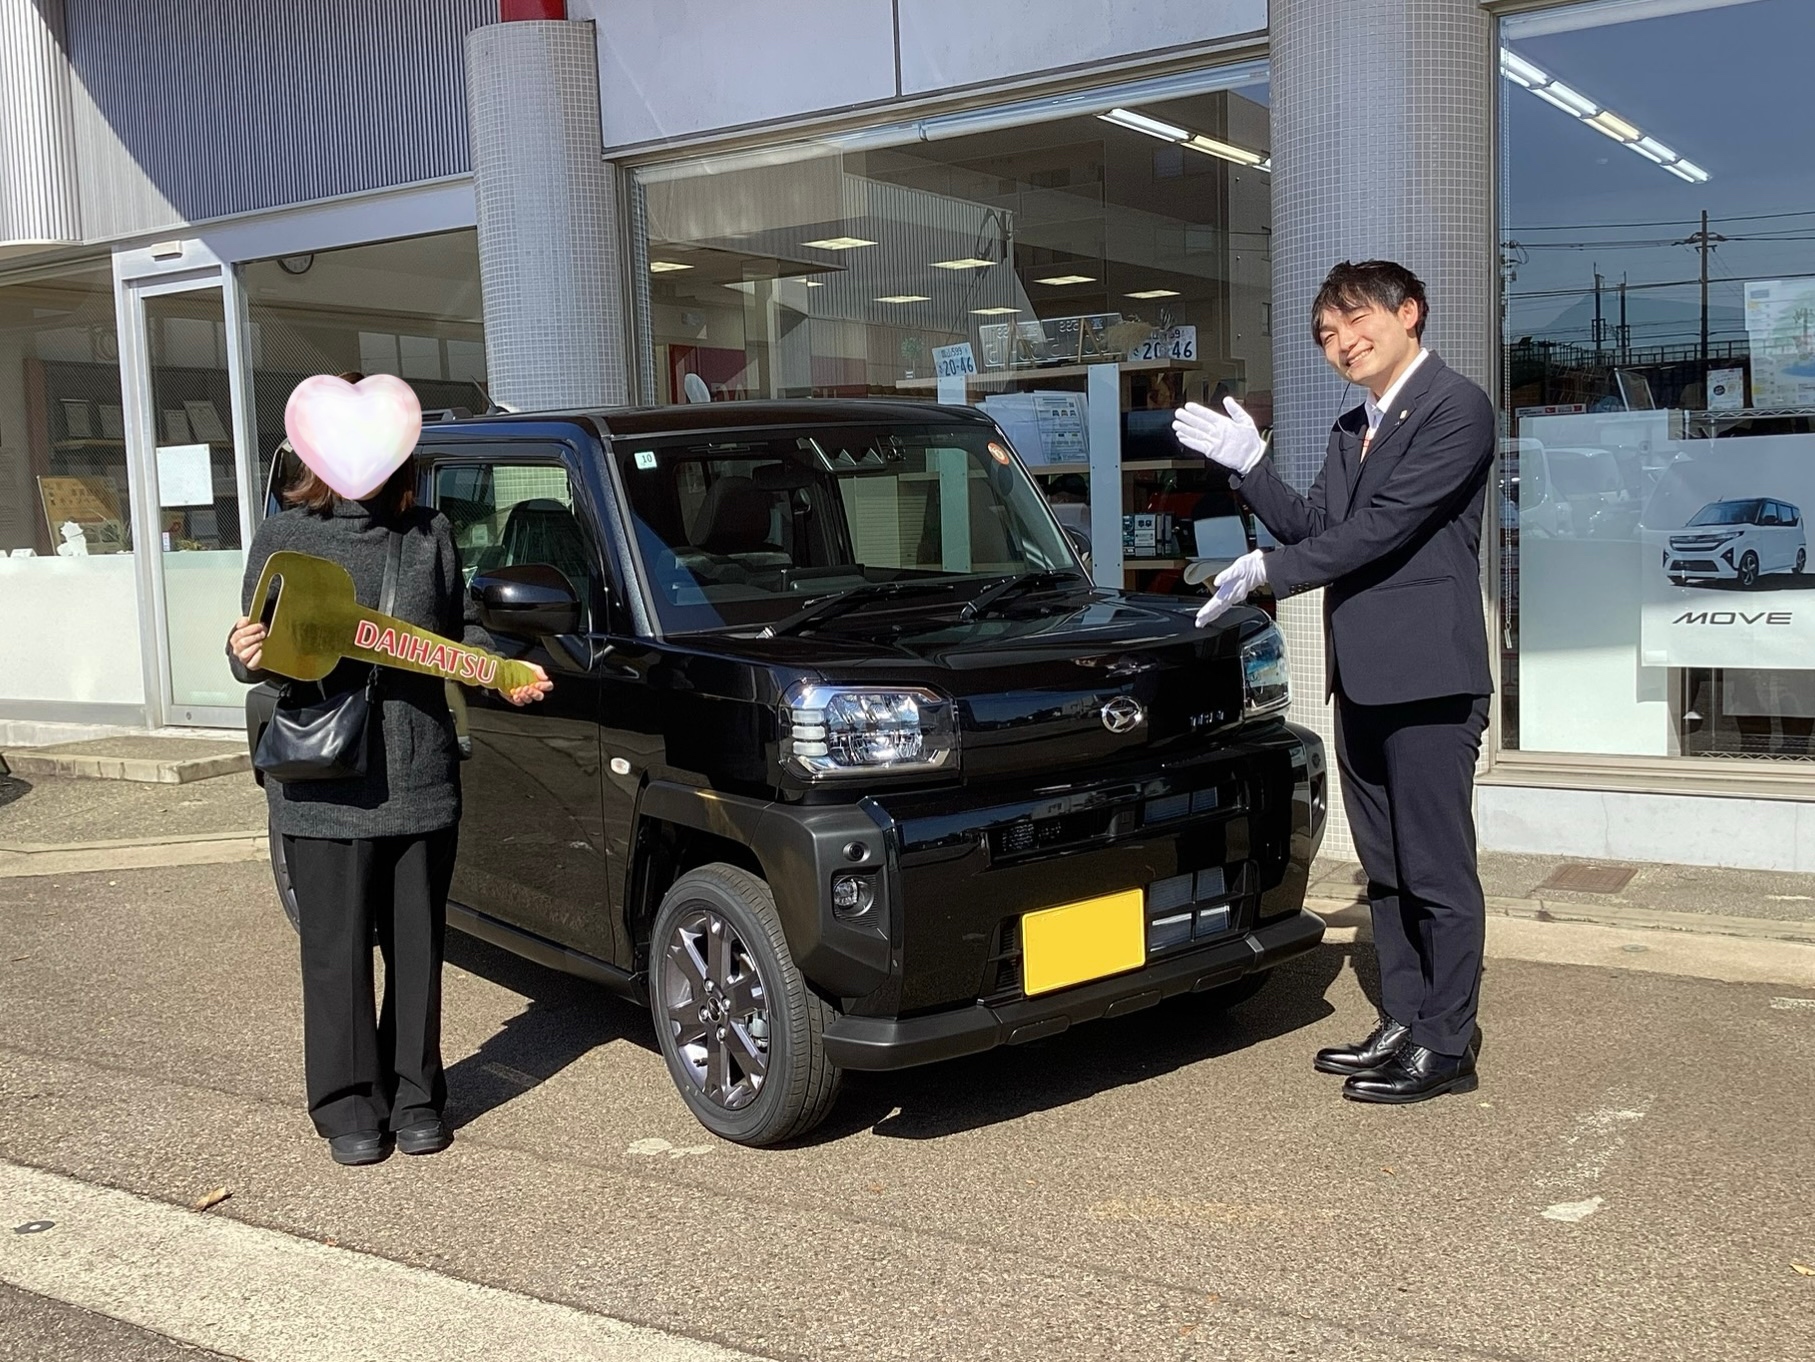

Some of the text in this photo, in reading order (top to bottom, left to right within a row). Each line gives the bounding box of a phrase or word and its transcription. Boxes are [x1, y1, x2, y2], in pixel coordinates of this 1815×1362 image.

[642, 453, 653, 463] 10
[1672, 612, 1793, 625] MOVE
[354, 619, 497, 684] DAIHATSU
